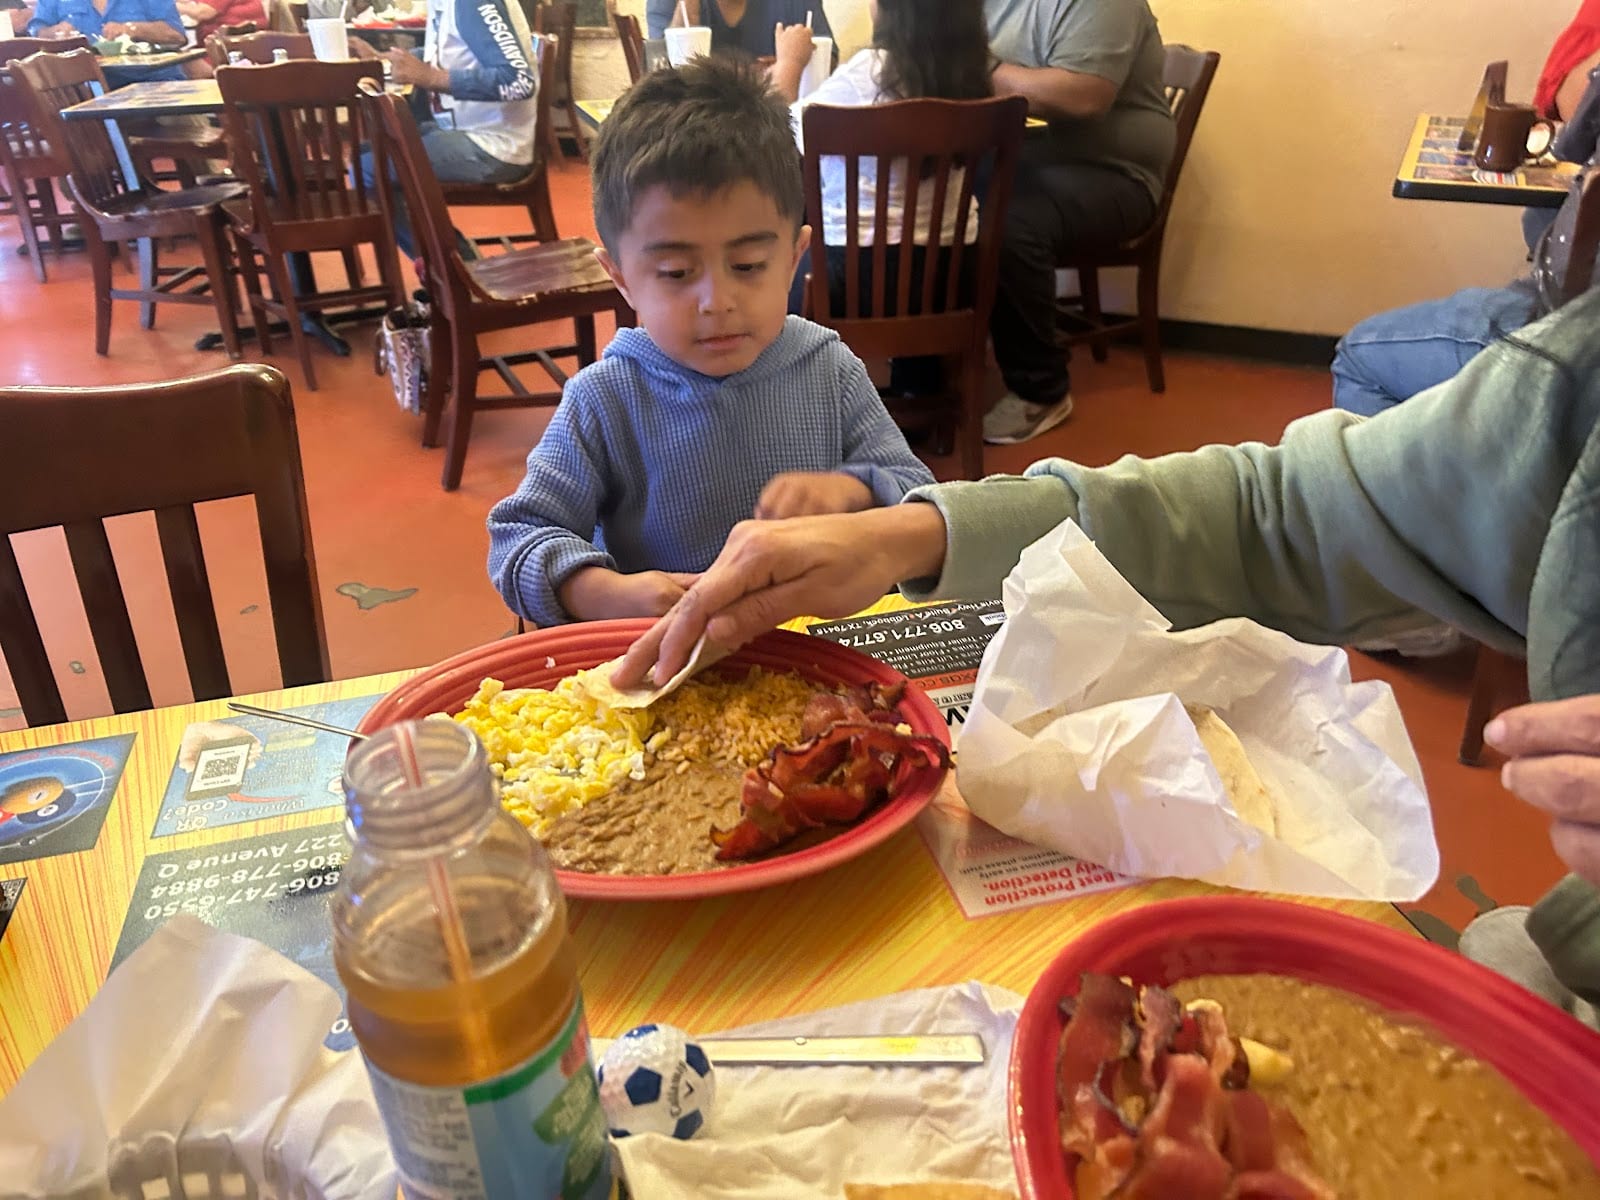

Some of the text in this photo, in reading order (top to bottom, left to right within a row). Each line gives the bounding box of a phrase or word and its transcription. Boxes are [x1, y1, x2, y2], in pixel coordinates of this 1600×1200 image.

[477, 4, 528, 69] DAVIDSON
[838, 619, 965, 647] 806.771.6774
[847, 622, 862, 630] TX
[894, 640, 946, 655] Equipment
[947, 635, 977, 646] Trailer
[871, 650, 888, 659] Lift
[920, 649, 945, 658] Floor
[910, 663, 945, 674] Covers
[163, 799, 228, 821] Code?
[176, 815, 208, 832] QR
[158, 833, 343, 879] 227 Avenue Q
[151, 852, 342, 899] 806-778-9884
[983, 867, 1072, 891] Detection.
[143, 870, 340, 920] 806-747-6550
[984, 871, 1115, 906] Best Protection
